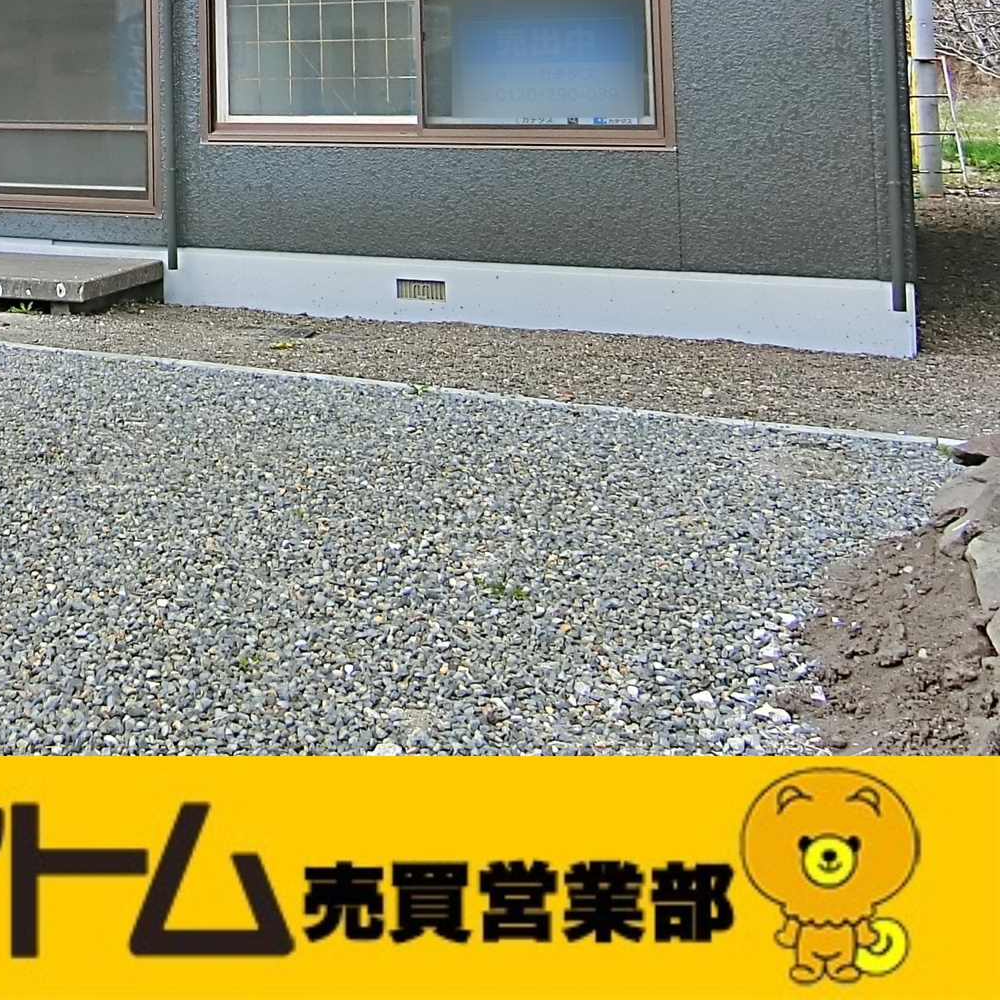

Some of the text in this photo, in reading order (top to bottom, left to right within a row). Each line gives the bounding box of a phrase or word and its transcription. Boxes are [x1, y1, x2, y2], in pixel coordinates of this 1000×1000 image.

[496, 25, 595, 57] 売出中
[496, 87, 618, 102] 0120-290-089
